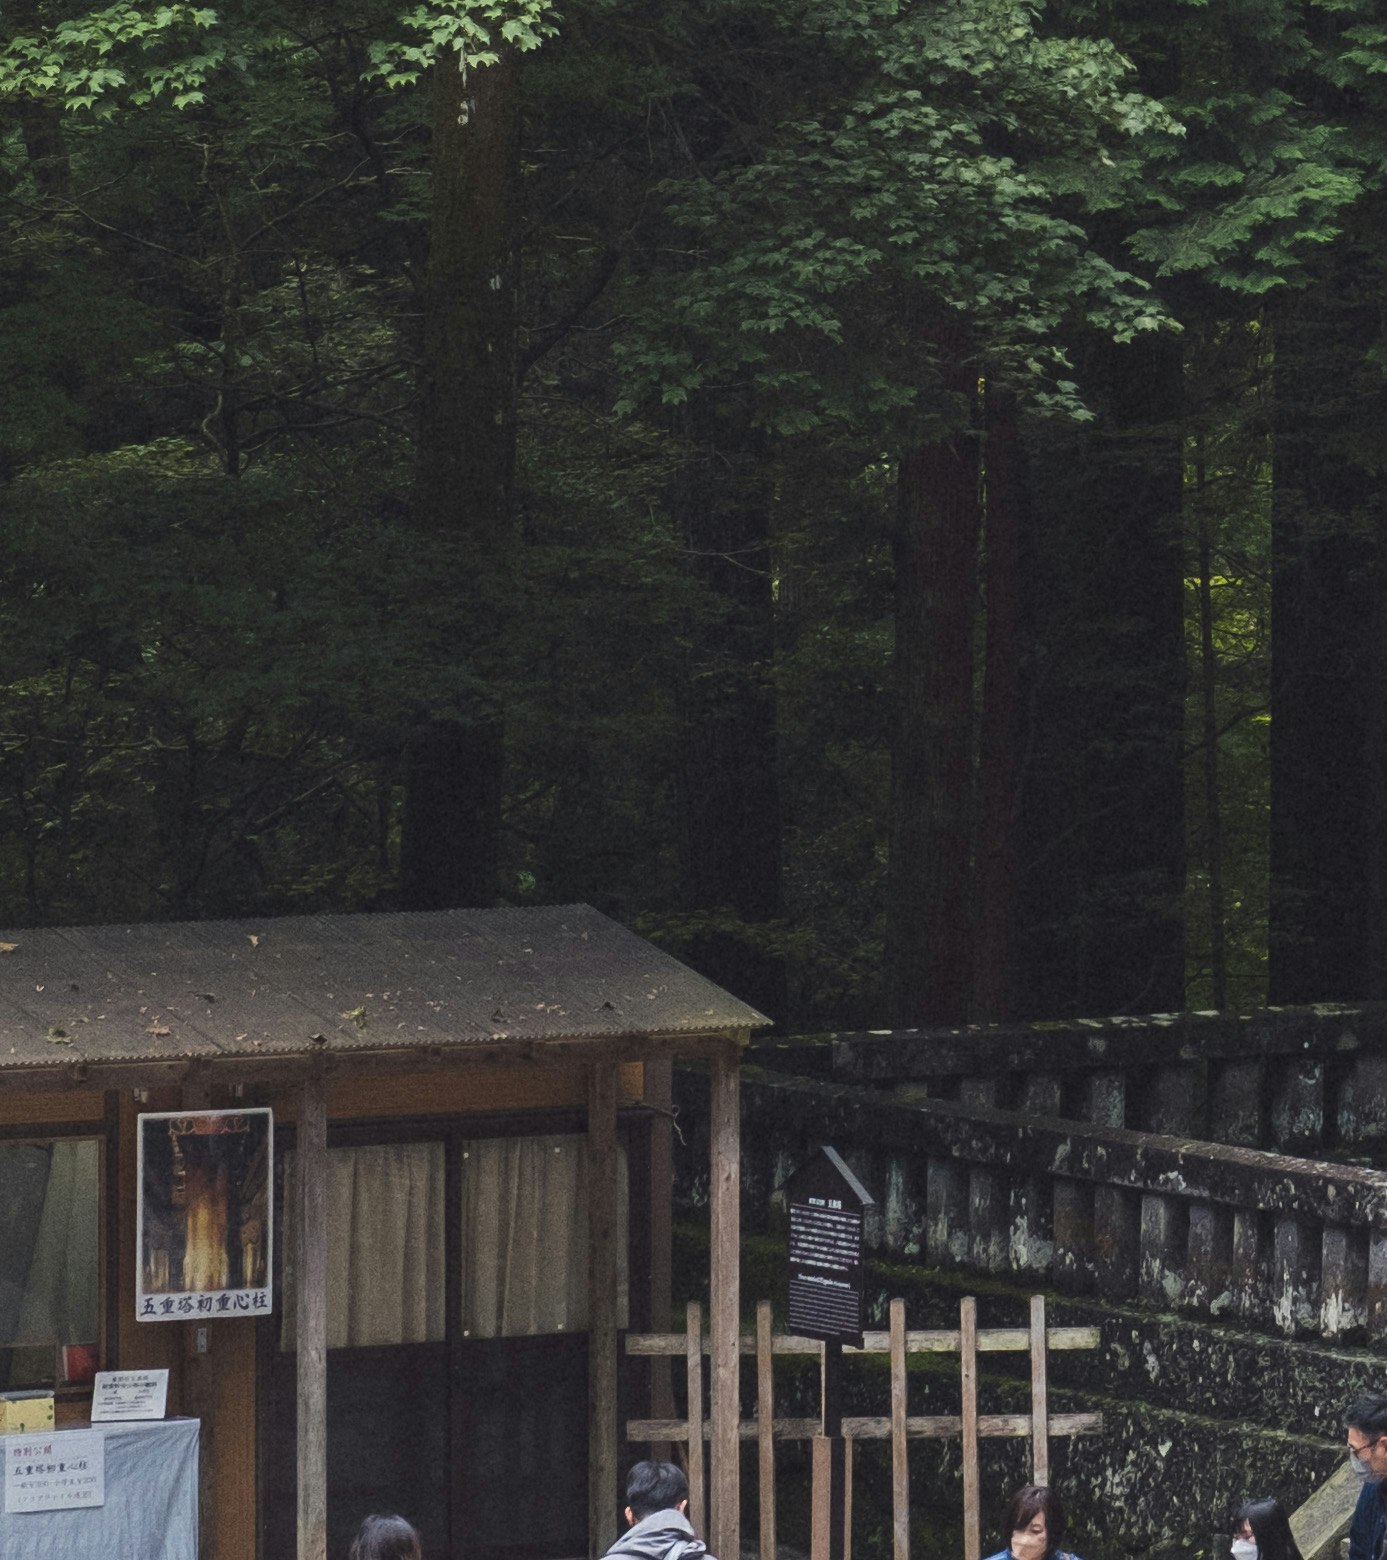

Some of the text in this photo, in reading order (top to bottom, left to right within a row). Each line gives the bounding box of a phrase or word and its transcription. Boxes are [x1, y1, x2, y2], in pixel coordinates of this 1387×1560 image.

[140, 1291, 268, 1317] 五重塔初重心柱
